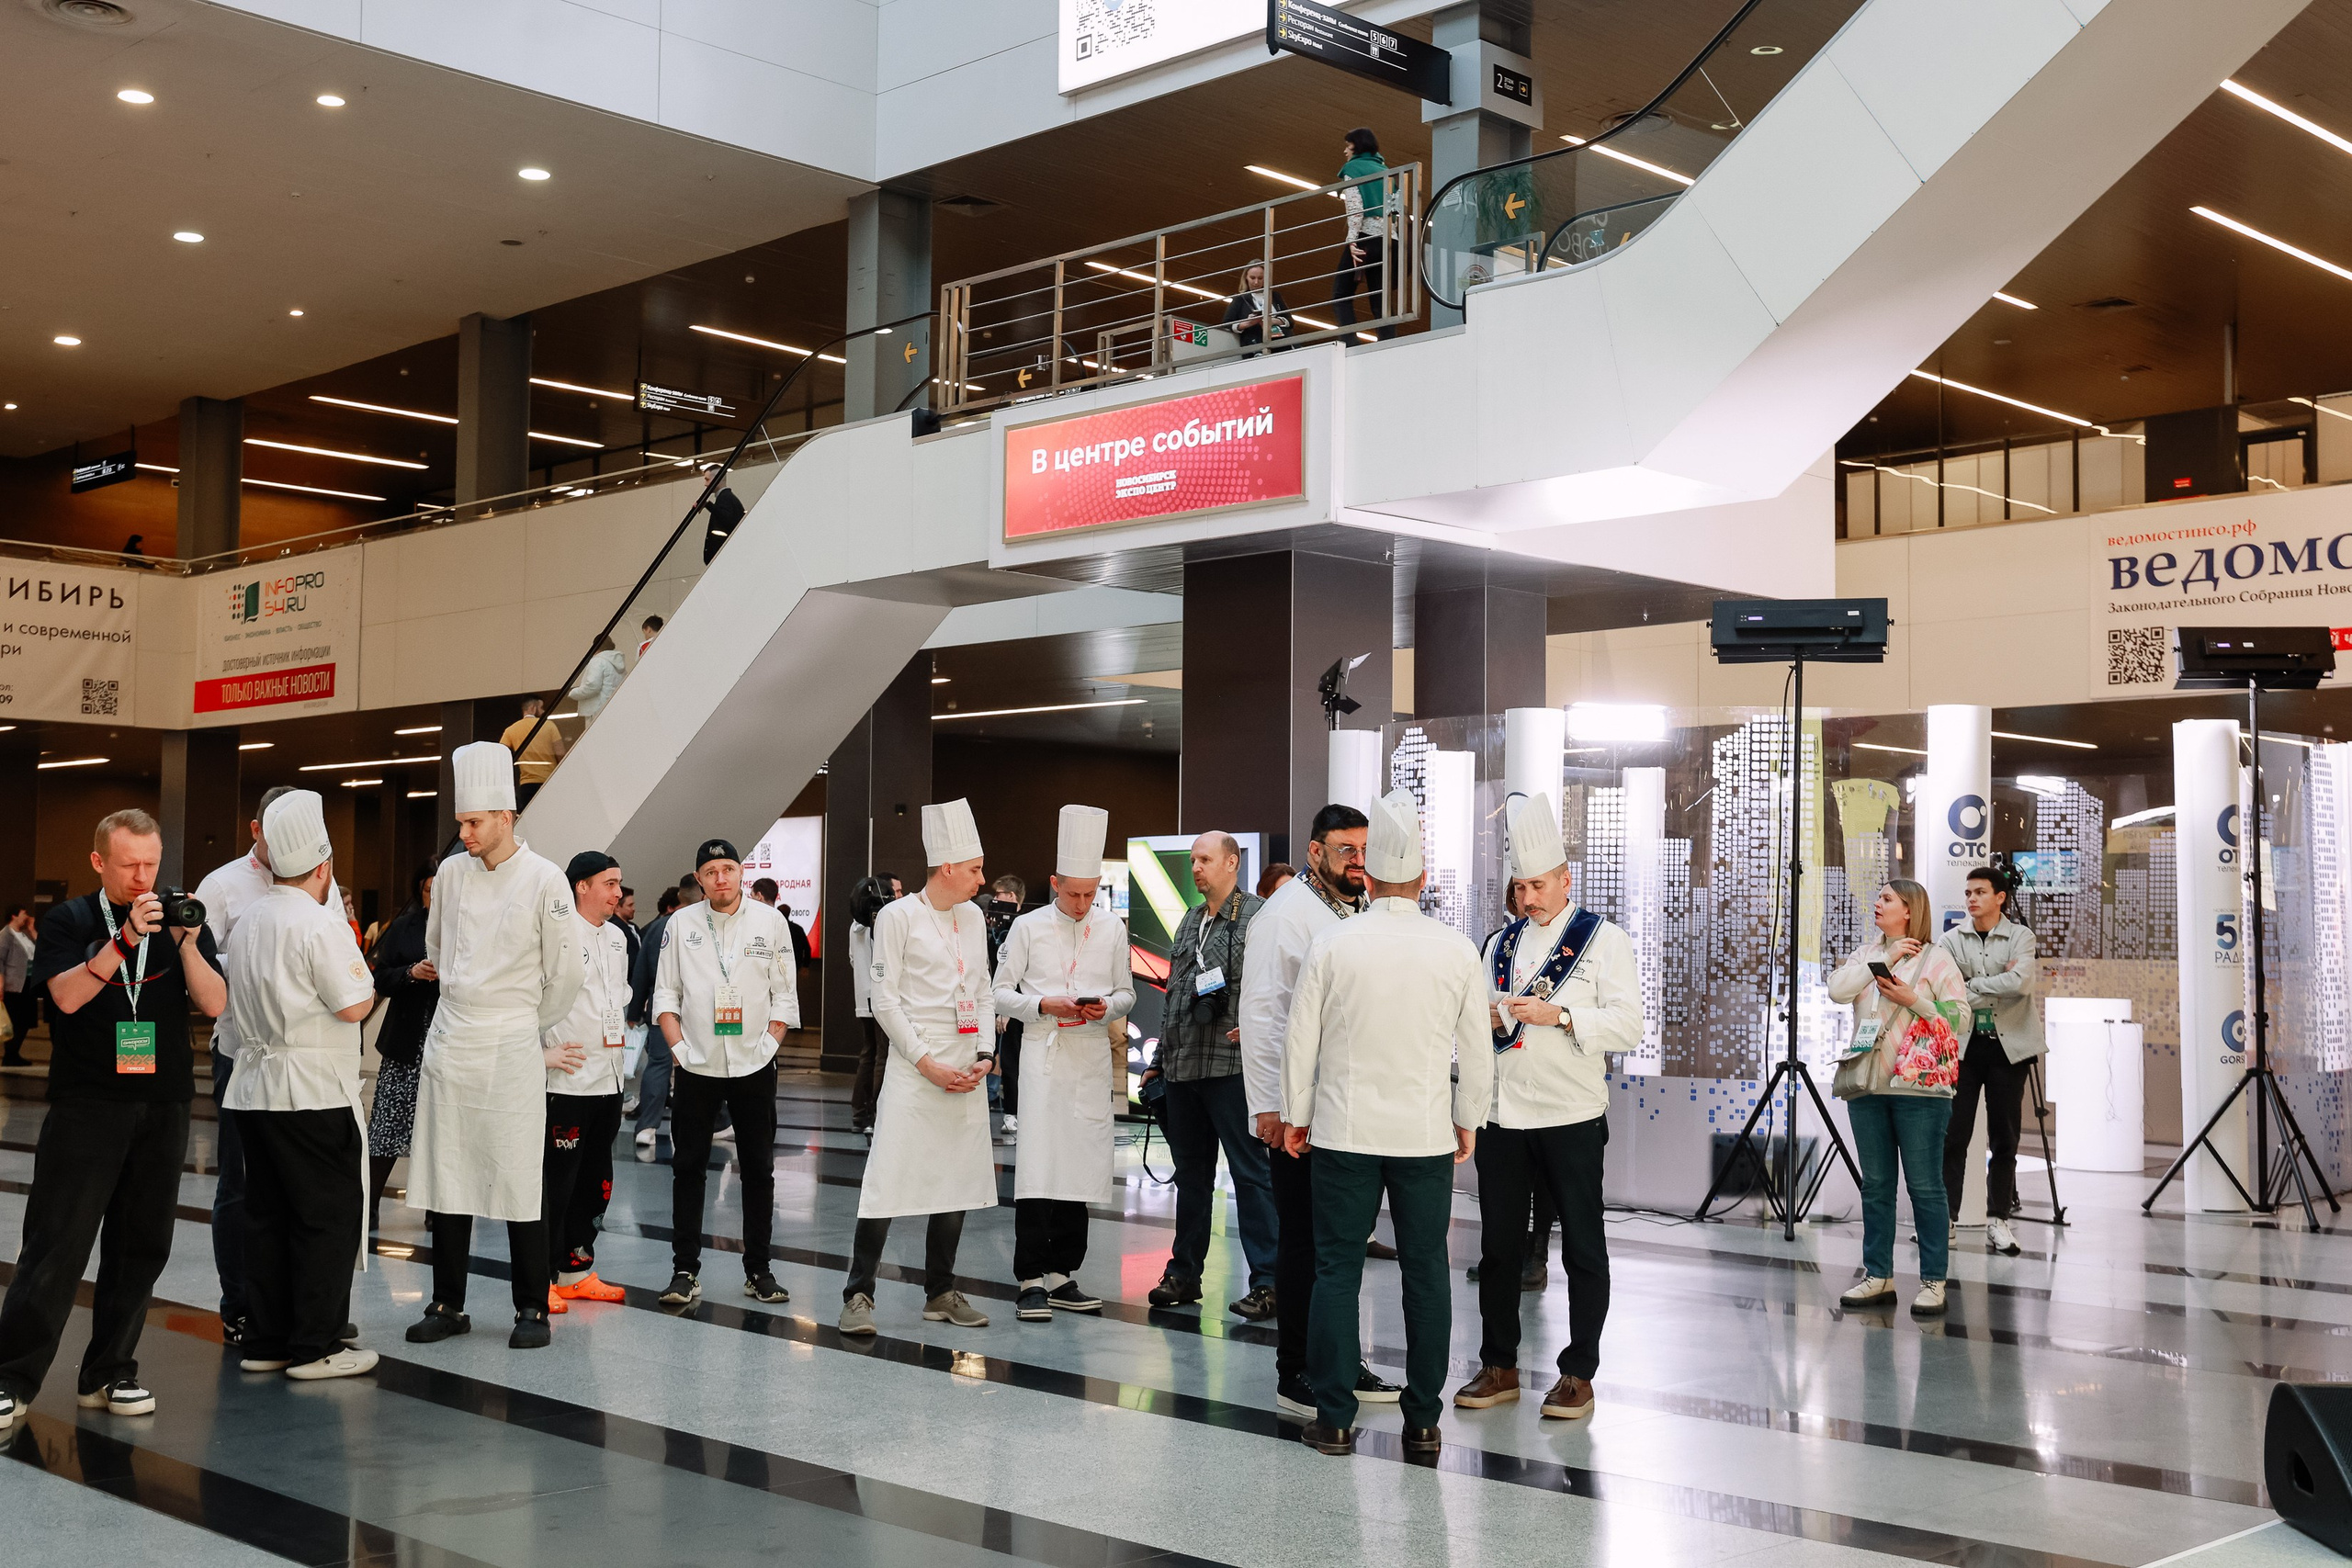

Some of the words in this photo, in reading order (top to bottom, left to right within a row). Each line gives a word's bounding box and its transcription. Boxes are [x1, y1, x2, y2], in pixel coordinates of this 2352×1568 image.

[1287, 15, 1314, 31] Ресторан
[1287, 29, 1313, 46] SkyExpo
[1497, 73, 1503, 88] 2
[1032, 448, 1048, 474] В
[1054, 435, 1146, 474] центре
[1152, 406, 1274, 454] событий
[1114, 469, 1177, 489] НОВОСИБИРСК
[1114, 485, 1146, 499] ЭКСПО
[1146, 480, 1177, 495] ЦЕНТР
[2108, 518, 2257, 547] ведомостинсо.рф
[0, 576, 125, 609] ИБИРЬ
[265, 571, 324, 597] INFOPRO
[265, 595, 307, 617] 54.RU
[2108, 594, 2235, 614] Законодательного
[2239, 588, 2312, 604] Собрания
[2317, 583, 2352, 596] Ново
[4, 623, 13, 633] и
[19, 624, 131, 644] современной
[222, 653, 262, 672] достоверный
[262, 651, 291, 666] источник
[291, 645, 331, 663] информации
[221, 682, 254, 704] ТОЛЬКО
[254, 676, 289, 700] ВАЖНЫЕ
[290, 671, 330, 695] НОВОСТИ
[1948, 841, 1987, 858] ОТС
[2219, 849, 2240, 863] ОТ
[743, 879, 811, 889] МЕАРОДНАЯ
[1230, 904, 1238, 921] Nikon
[1943, 910, 1966, 933] 5
[2216, 914, 2242, 950] 5
[2215, 951, 2243, 964] РАД
